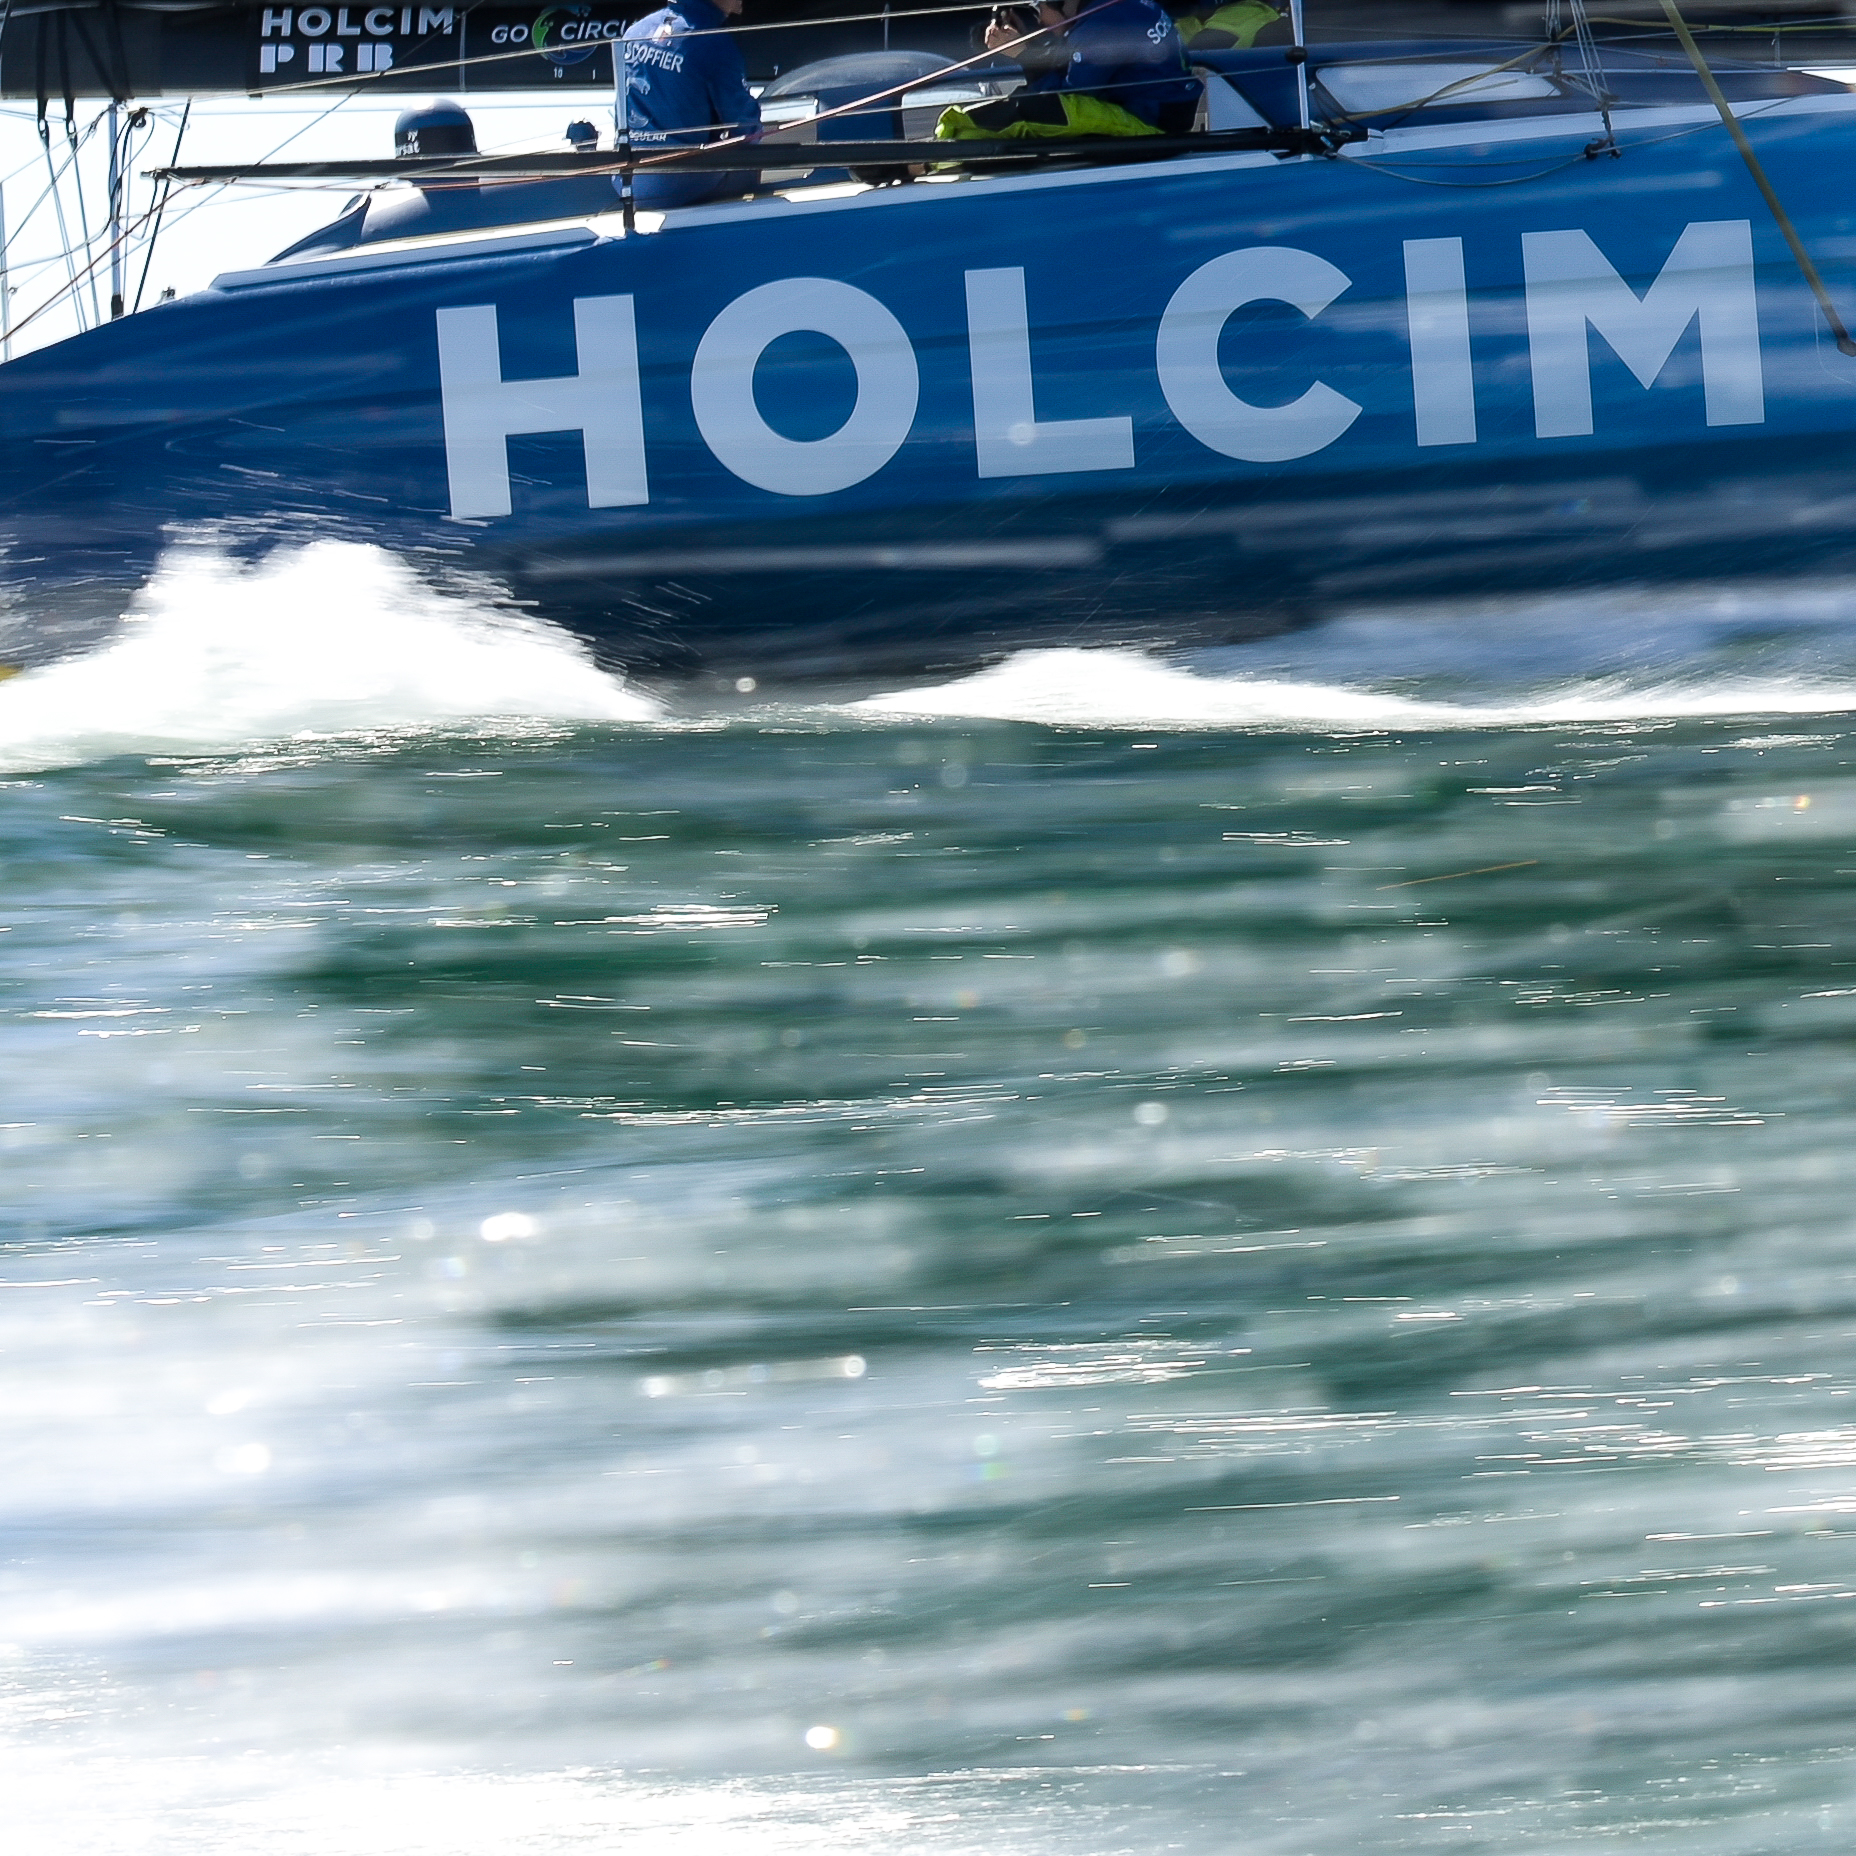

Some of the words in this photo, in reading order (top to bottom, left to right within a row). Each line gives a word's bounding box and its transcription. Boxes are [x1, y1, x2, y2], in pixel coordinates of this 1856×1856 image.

[260, 5, 454, 37] HOLCIM
[491, 25, 528, 43] GO
[560, 19, 634, 40] CIRC
[259, 43, 394, 74] PRB
[624, 41, 684, 74] SCOFFIER
[435, 218, 1766, 521] HOLCIM
